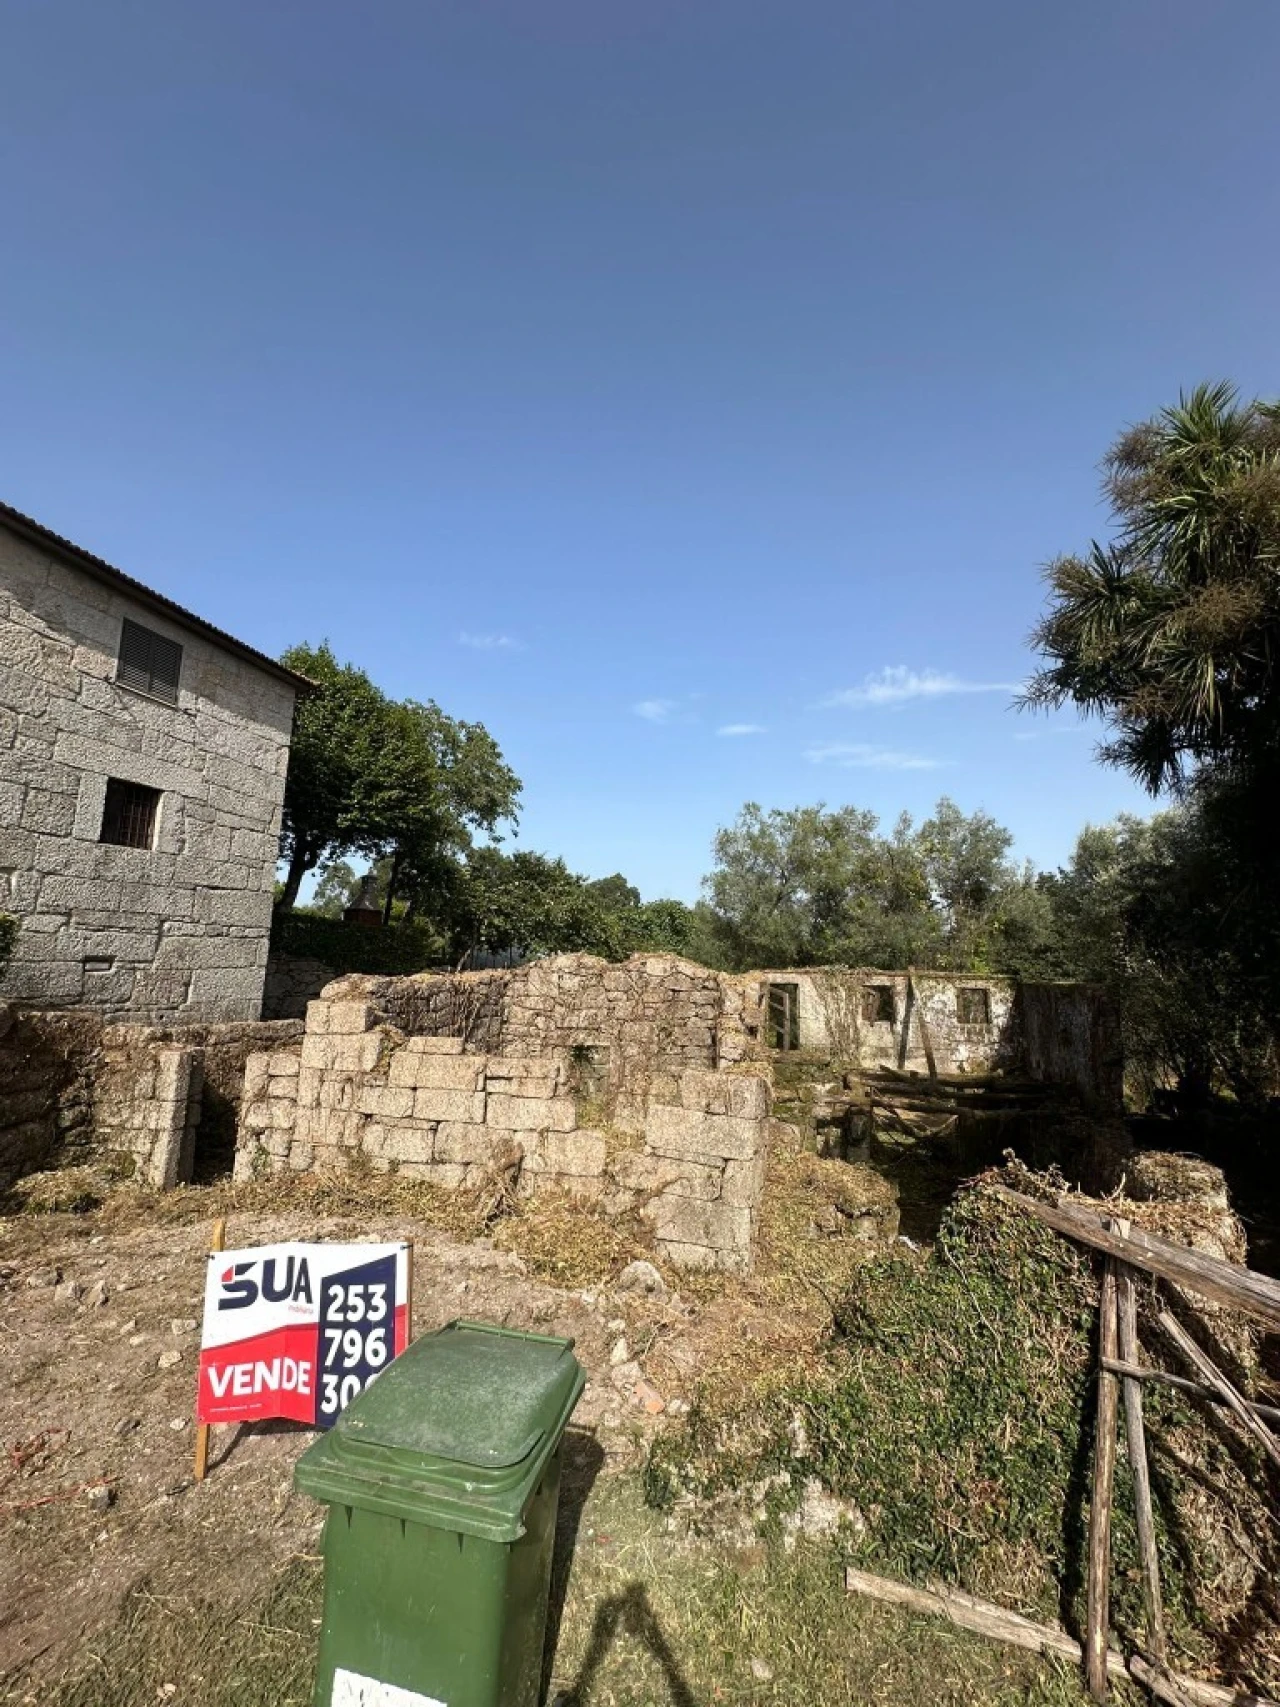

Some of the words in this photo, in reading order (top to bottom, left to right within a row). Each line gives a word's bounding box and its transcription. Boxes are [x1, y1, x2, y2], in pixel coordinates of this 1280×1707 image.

[218, 1255, 313, 1310] SUA
[326, 1284, 387, 1322] 253
[324, 1328, 387, 1367] 796
[208, 1357, 311, 1397] VENDE
[321, 1374, 380, 1413] 30
